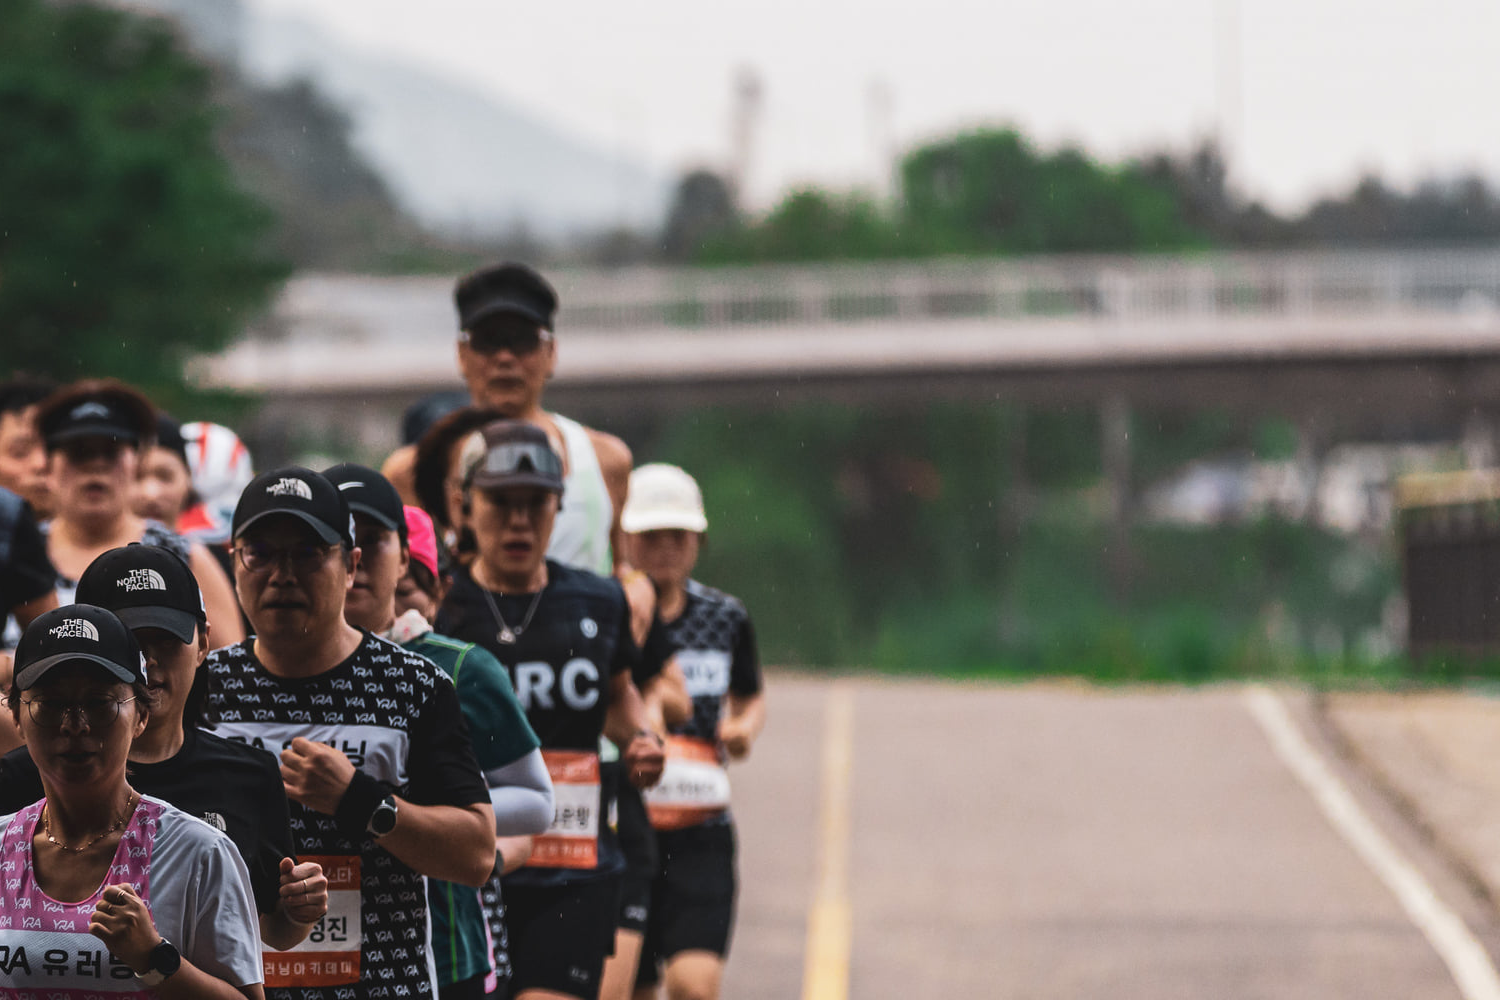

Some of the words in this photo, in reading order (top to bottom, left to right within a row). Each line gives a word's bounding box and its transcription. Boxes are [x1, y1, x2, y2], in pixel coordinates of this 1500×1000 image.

[128, 568, 148, 577] THE
[116, 576, 149, 587] NORTH
[126, 582, 150, 592] FACE
[62, 618, 83, 626] THE
[49, 624, 82, 636] NORTH
[58, 631, 83, 639] FACE
[221, 678, 244, 689] YRA
[331, 680, 352, 691] YRA
[503, 658, 599, 710] RC
[311, 694, 333, 705] YRA
[376, 698, 397, 709] YRA
[220, 710, 241, 720] YRA
[252, 709, 275, 720] YRA
[287, 710, 311, 722] YRA
[355, 713, 376, 724] YRA
[127, 847, 148, 858] YRA
[43, 900, 64, 913] YRA
[77, 904, 96, 914] YRA
[22, 917, 42, 928] YRA
[53, 919, 75, 931] YRA
